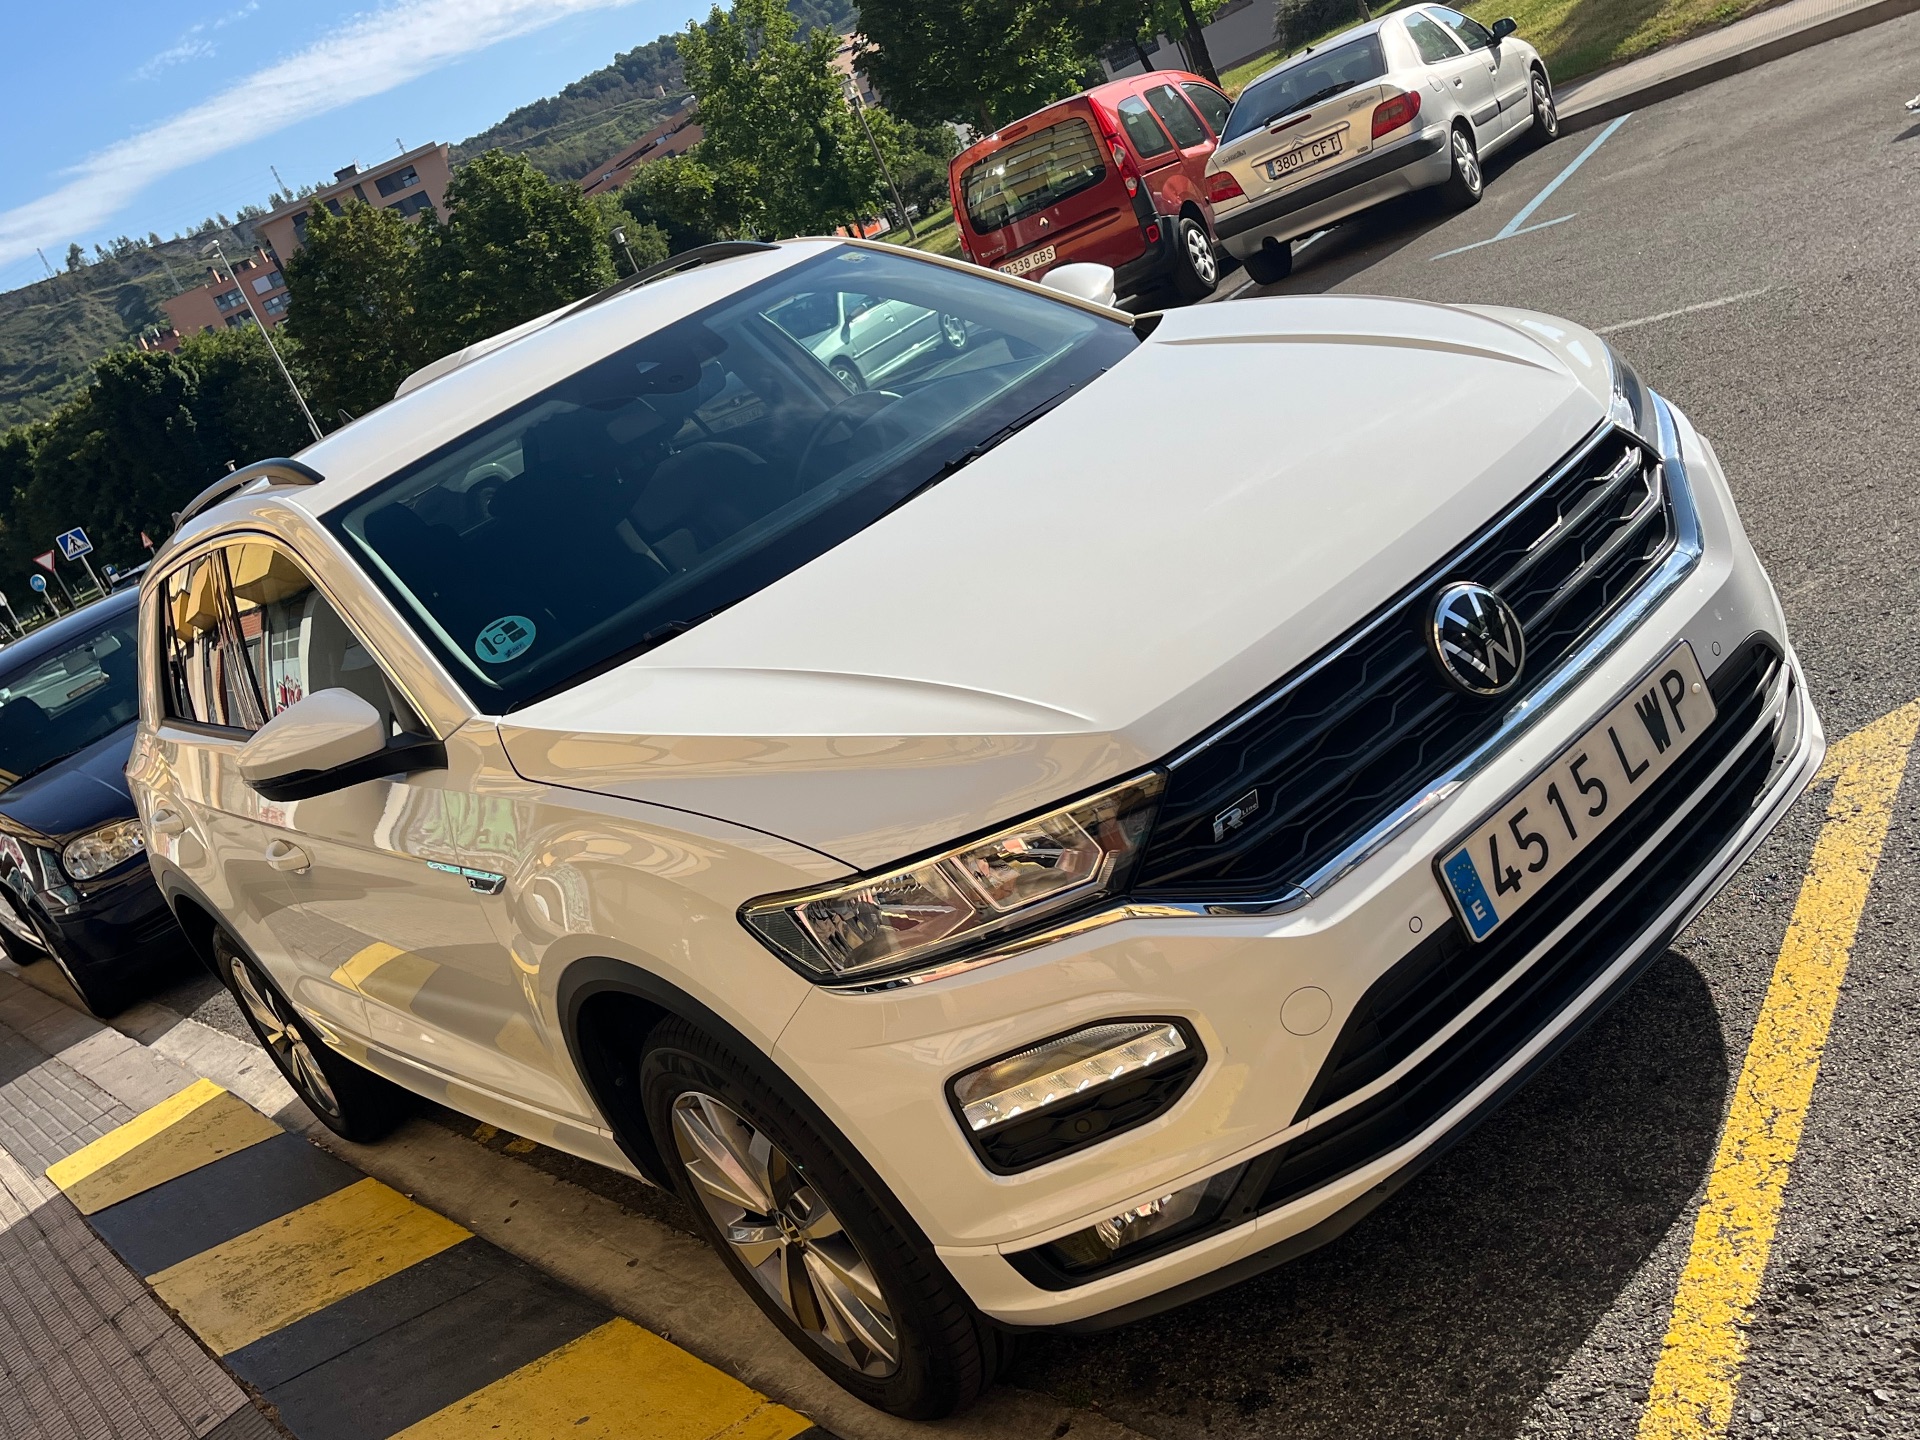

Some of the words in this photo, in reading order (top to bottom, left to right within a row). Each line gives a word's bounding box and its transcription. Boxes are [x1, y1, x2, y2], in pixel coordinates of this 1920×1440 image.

[1275, 150, 1304, 172] 3801
[1311, 136, 1336, 157] CFT
[1005, 257, 1031, 275] 9338
[1033, 248, 1053, 265] GBS
[105, 566, 113, 575] P
[1488, 752, 1608, 897] 4515
[1607, 668, 1686, 785] LWP
[1212, 807, 1244, 843] R
[1472, 899, 1486, 921] E
